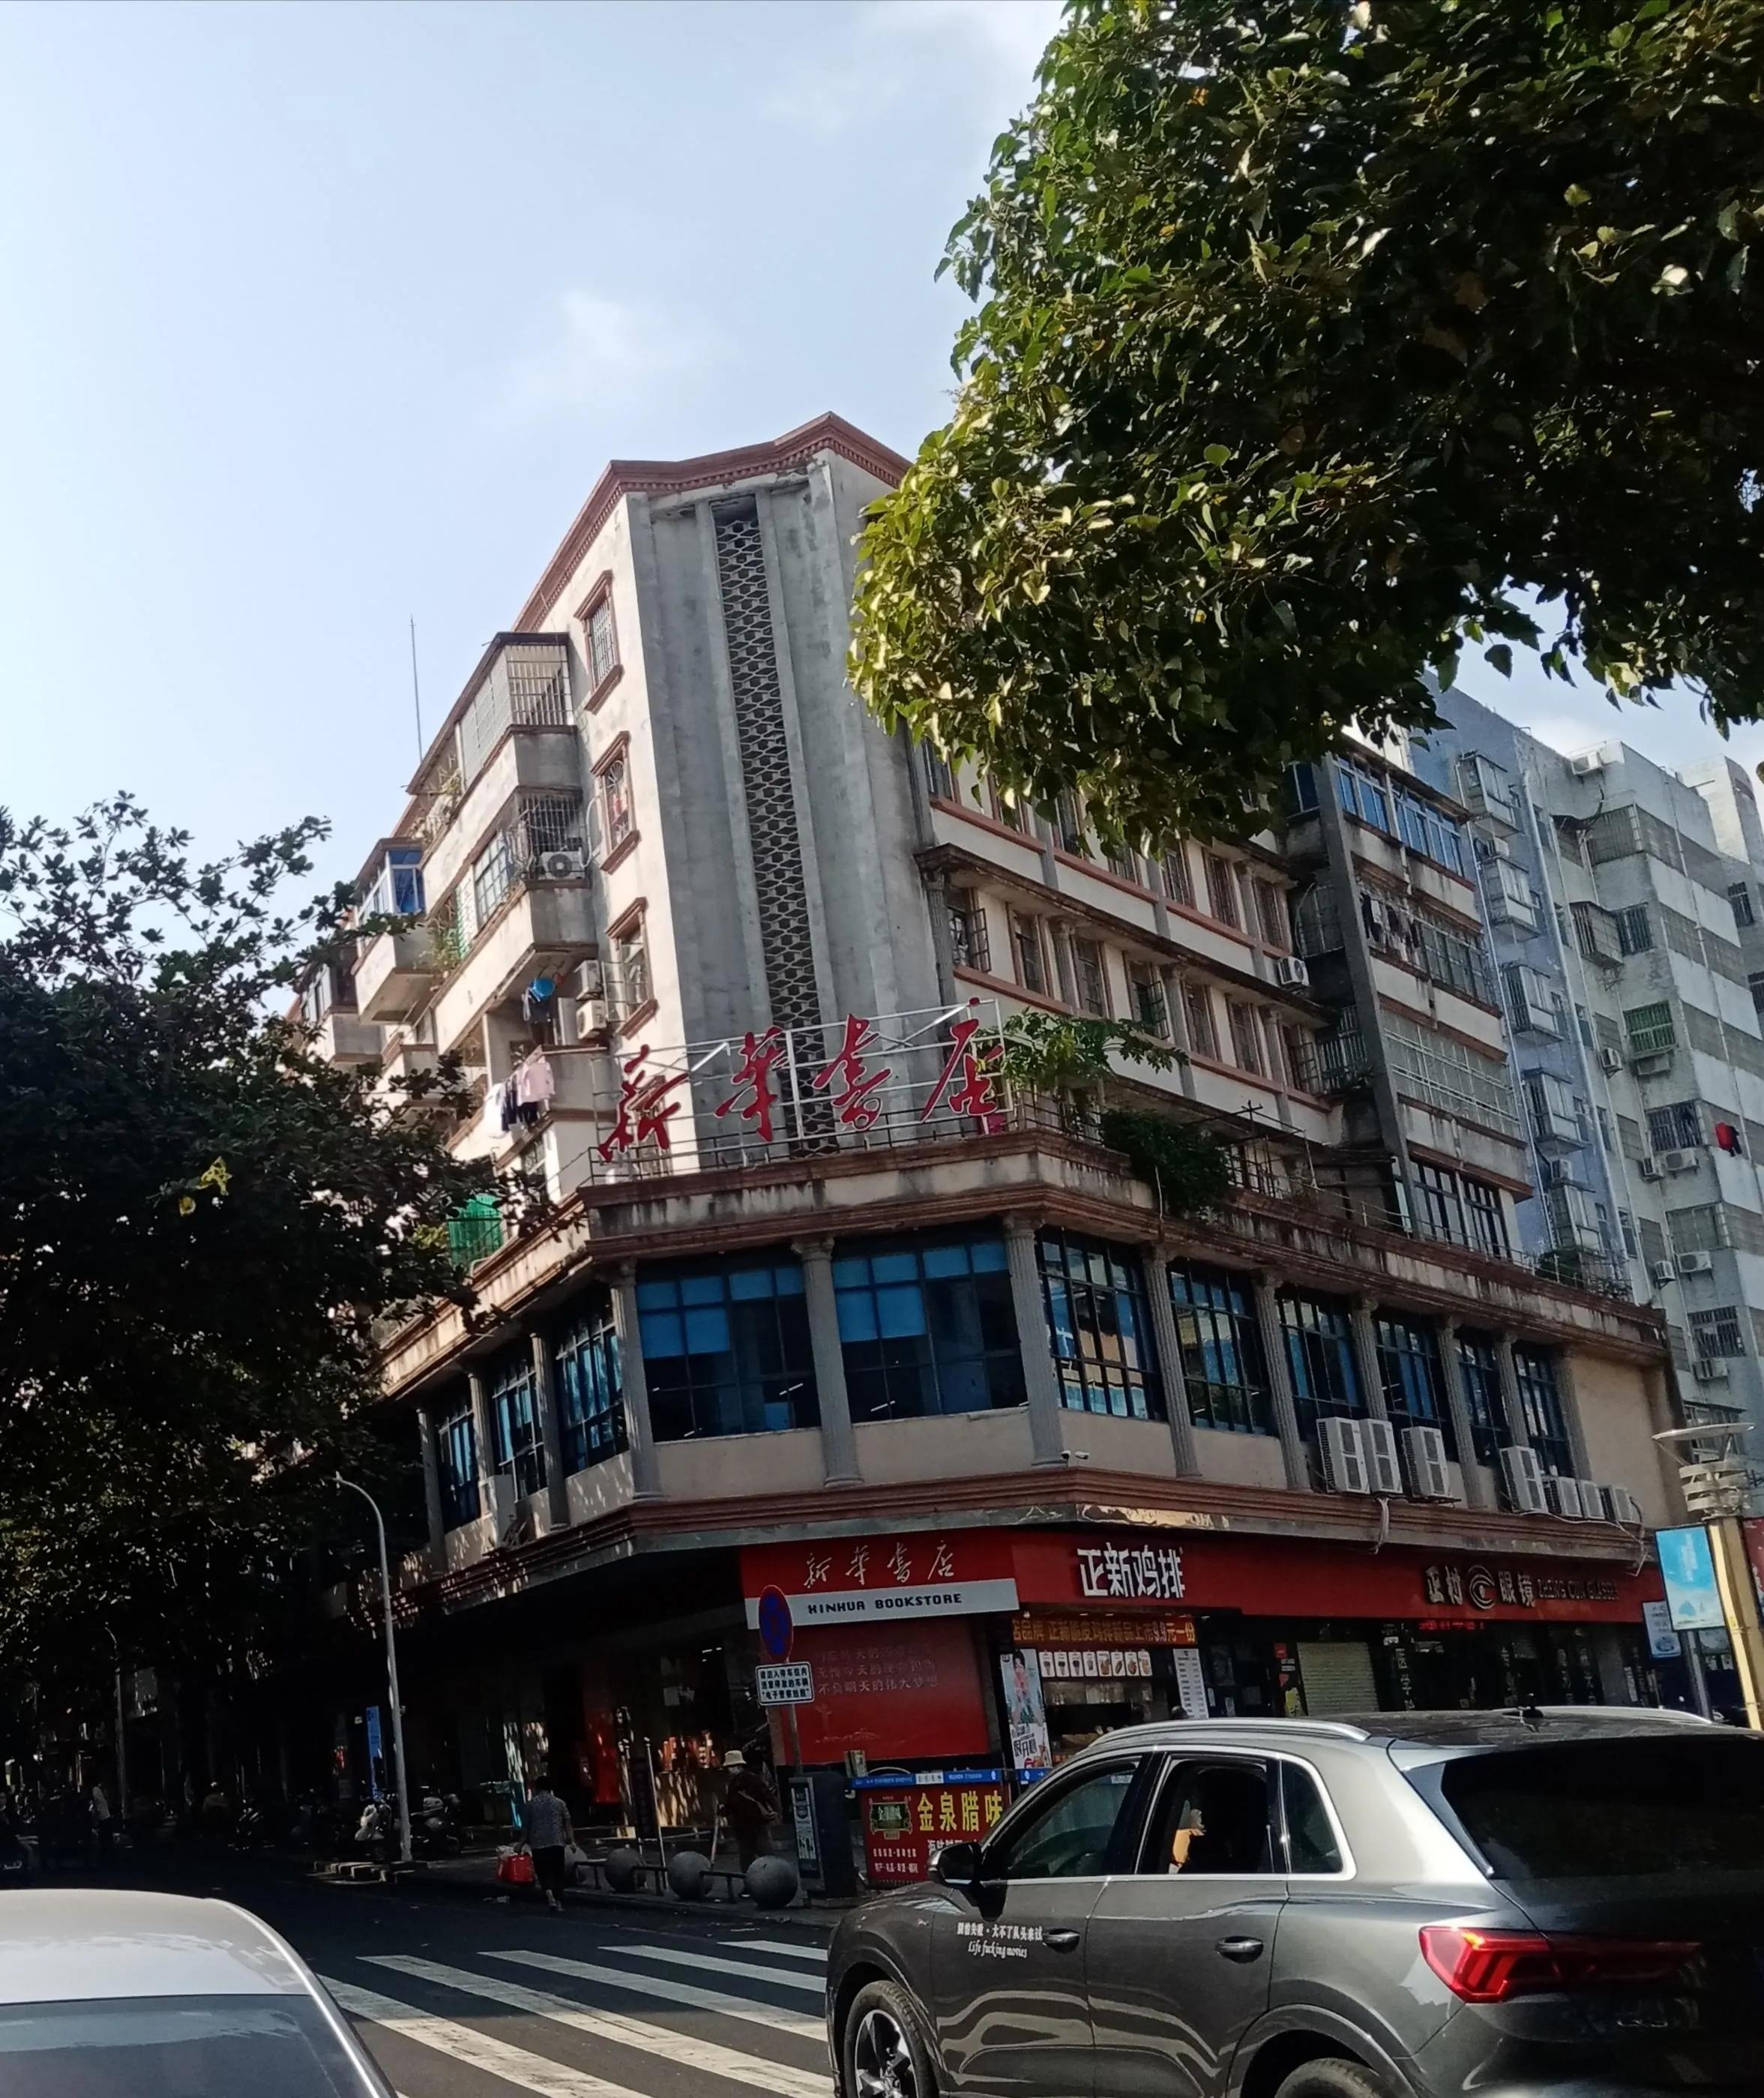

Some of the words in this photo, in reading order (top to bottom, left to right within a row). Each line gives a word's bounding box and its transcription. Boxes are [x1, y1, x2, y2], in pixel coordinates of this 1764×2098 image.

[1077, 1542, 1185, 1598] 正新鸡排
[808, 1600, 865, 1614] XINHUA
[875, 1593, 962, 1609] BOOKSTORE
[917, 1790, 1003, 1832] 金泉腊味
[968, 1939, 981, 1956] Life
